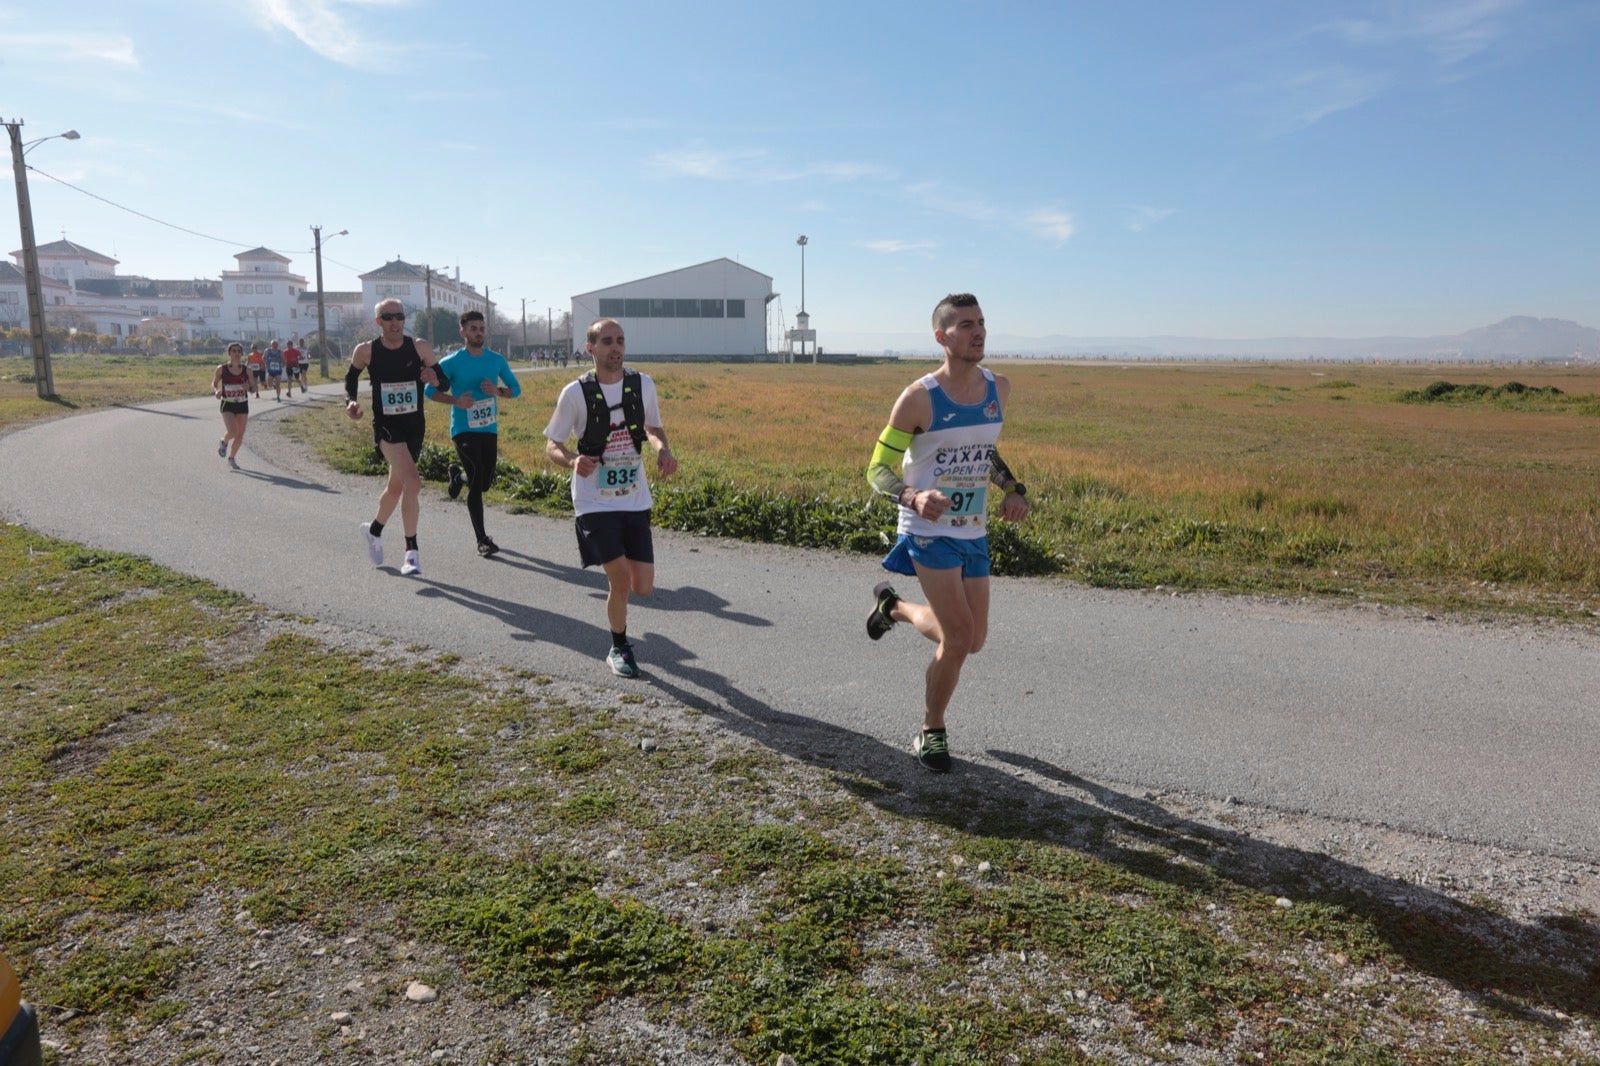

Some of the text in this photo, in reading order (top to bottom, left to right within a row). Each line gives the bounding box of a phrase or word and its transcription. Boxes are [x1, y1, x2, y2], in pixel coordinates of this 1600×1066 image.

[388, 392, 412, 405] 836
[472, 406, 492, 420] 352
[959, 443, 995, 451] ATLETISM
[936, 449, 995, 466] CAXAR
[607, 468, 637, 486] 835
[950, 491, 975, 512] 97
